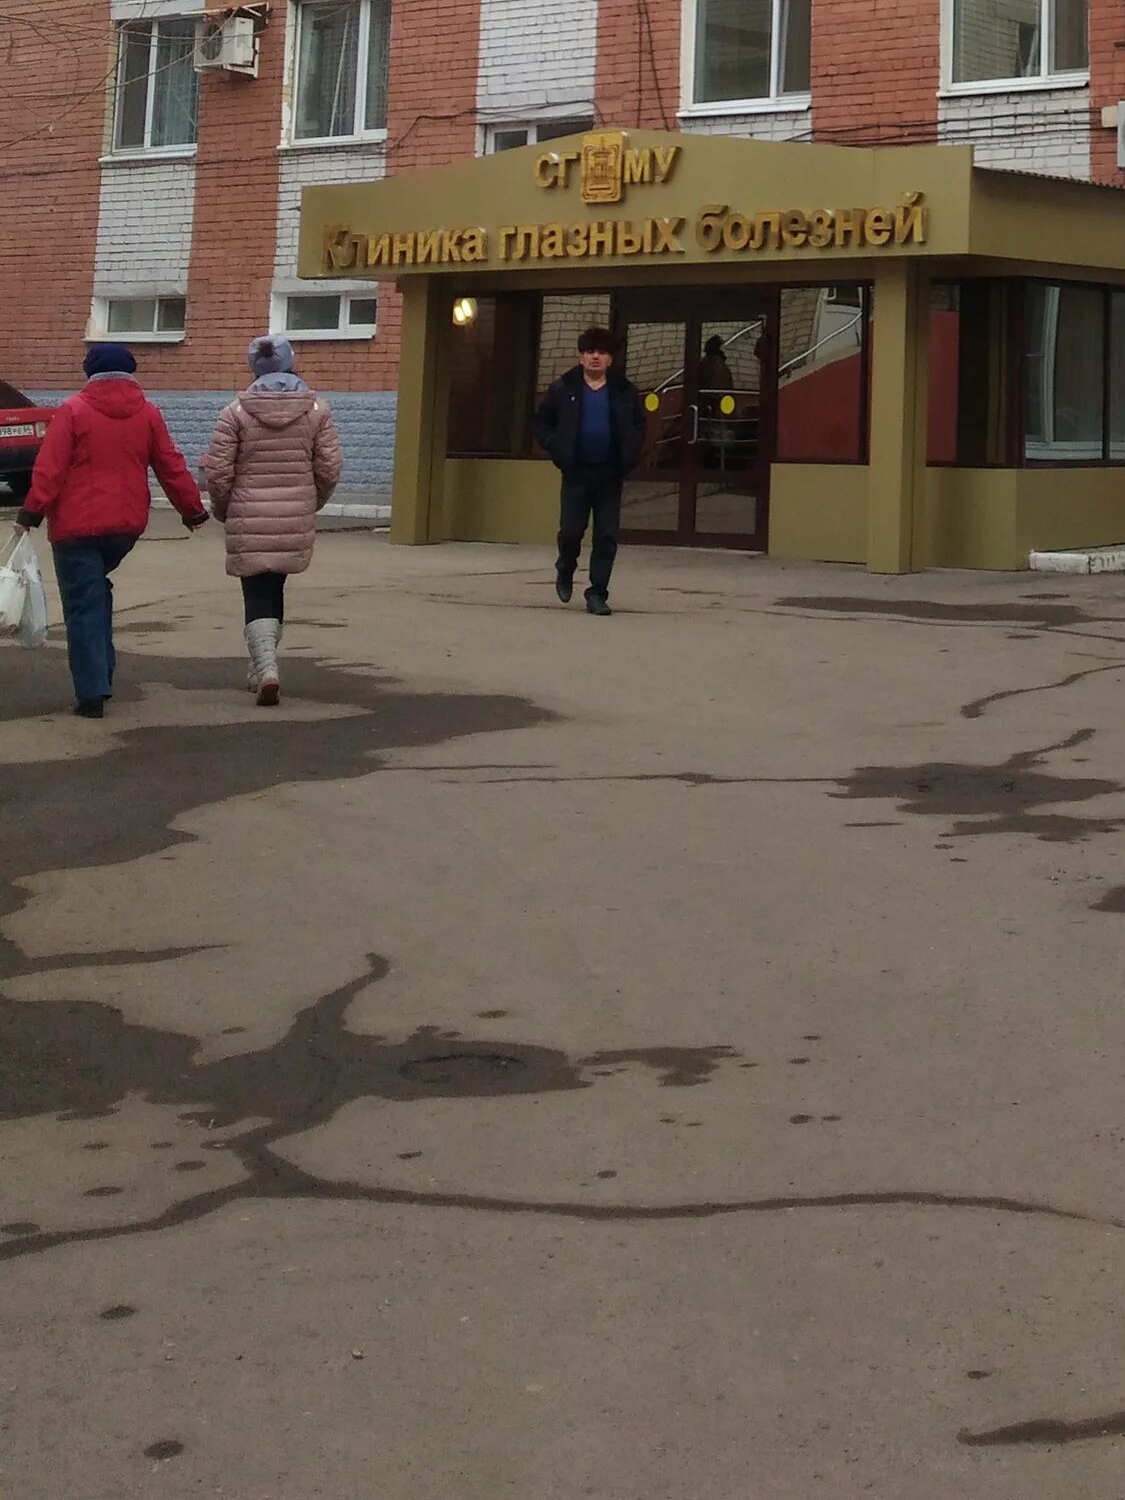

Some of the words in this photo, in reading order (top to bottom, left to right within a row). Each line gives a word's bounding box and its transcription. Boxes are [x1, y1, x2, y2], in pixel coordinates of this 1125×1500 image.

[322, 223, 488, 268] Клиника
[500, 216, 686, 260] глазных
[695, 190, 926, 252] болезней
